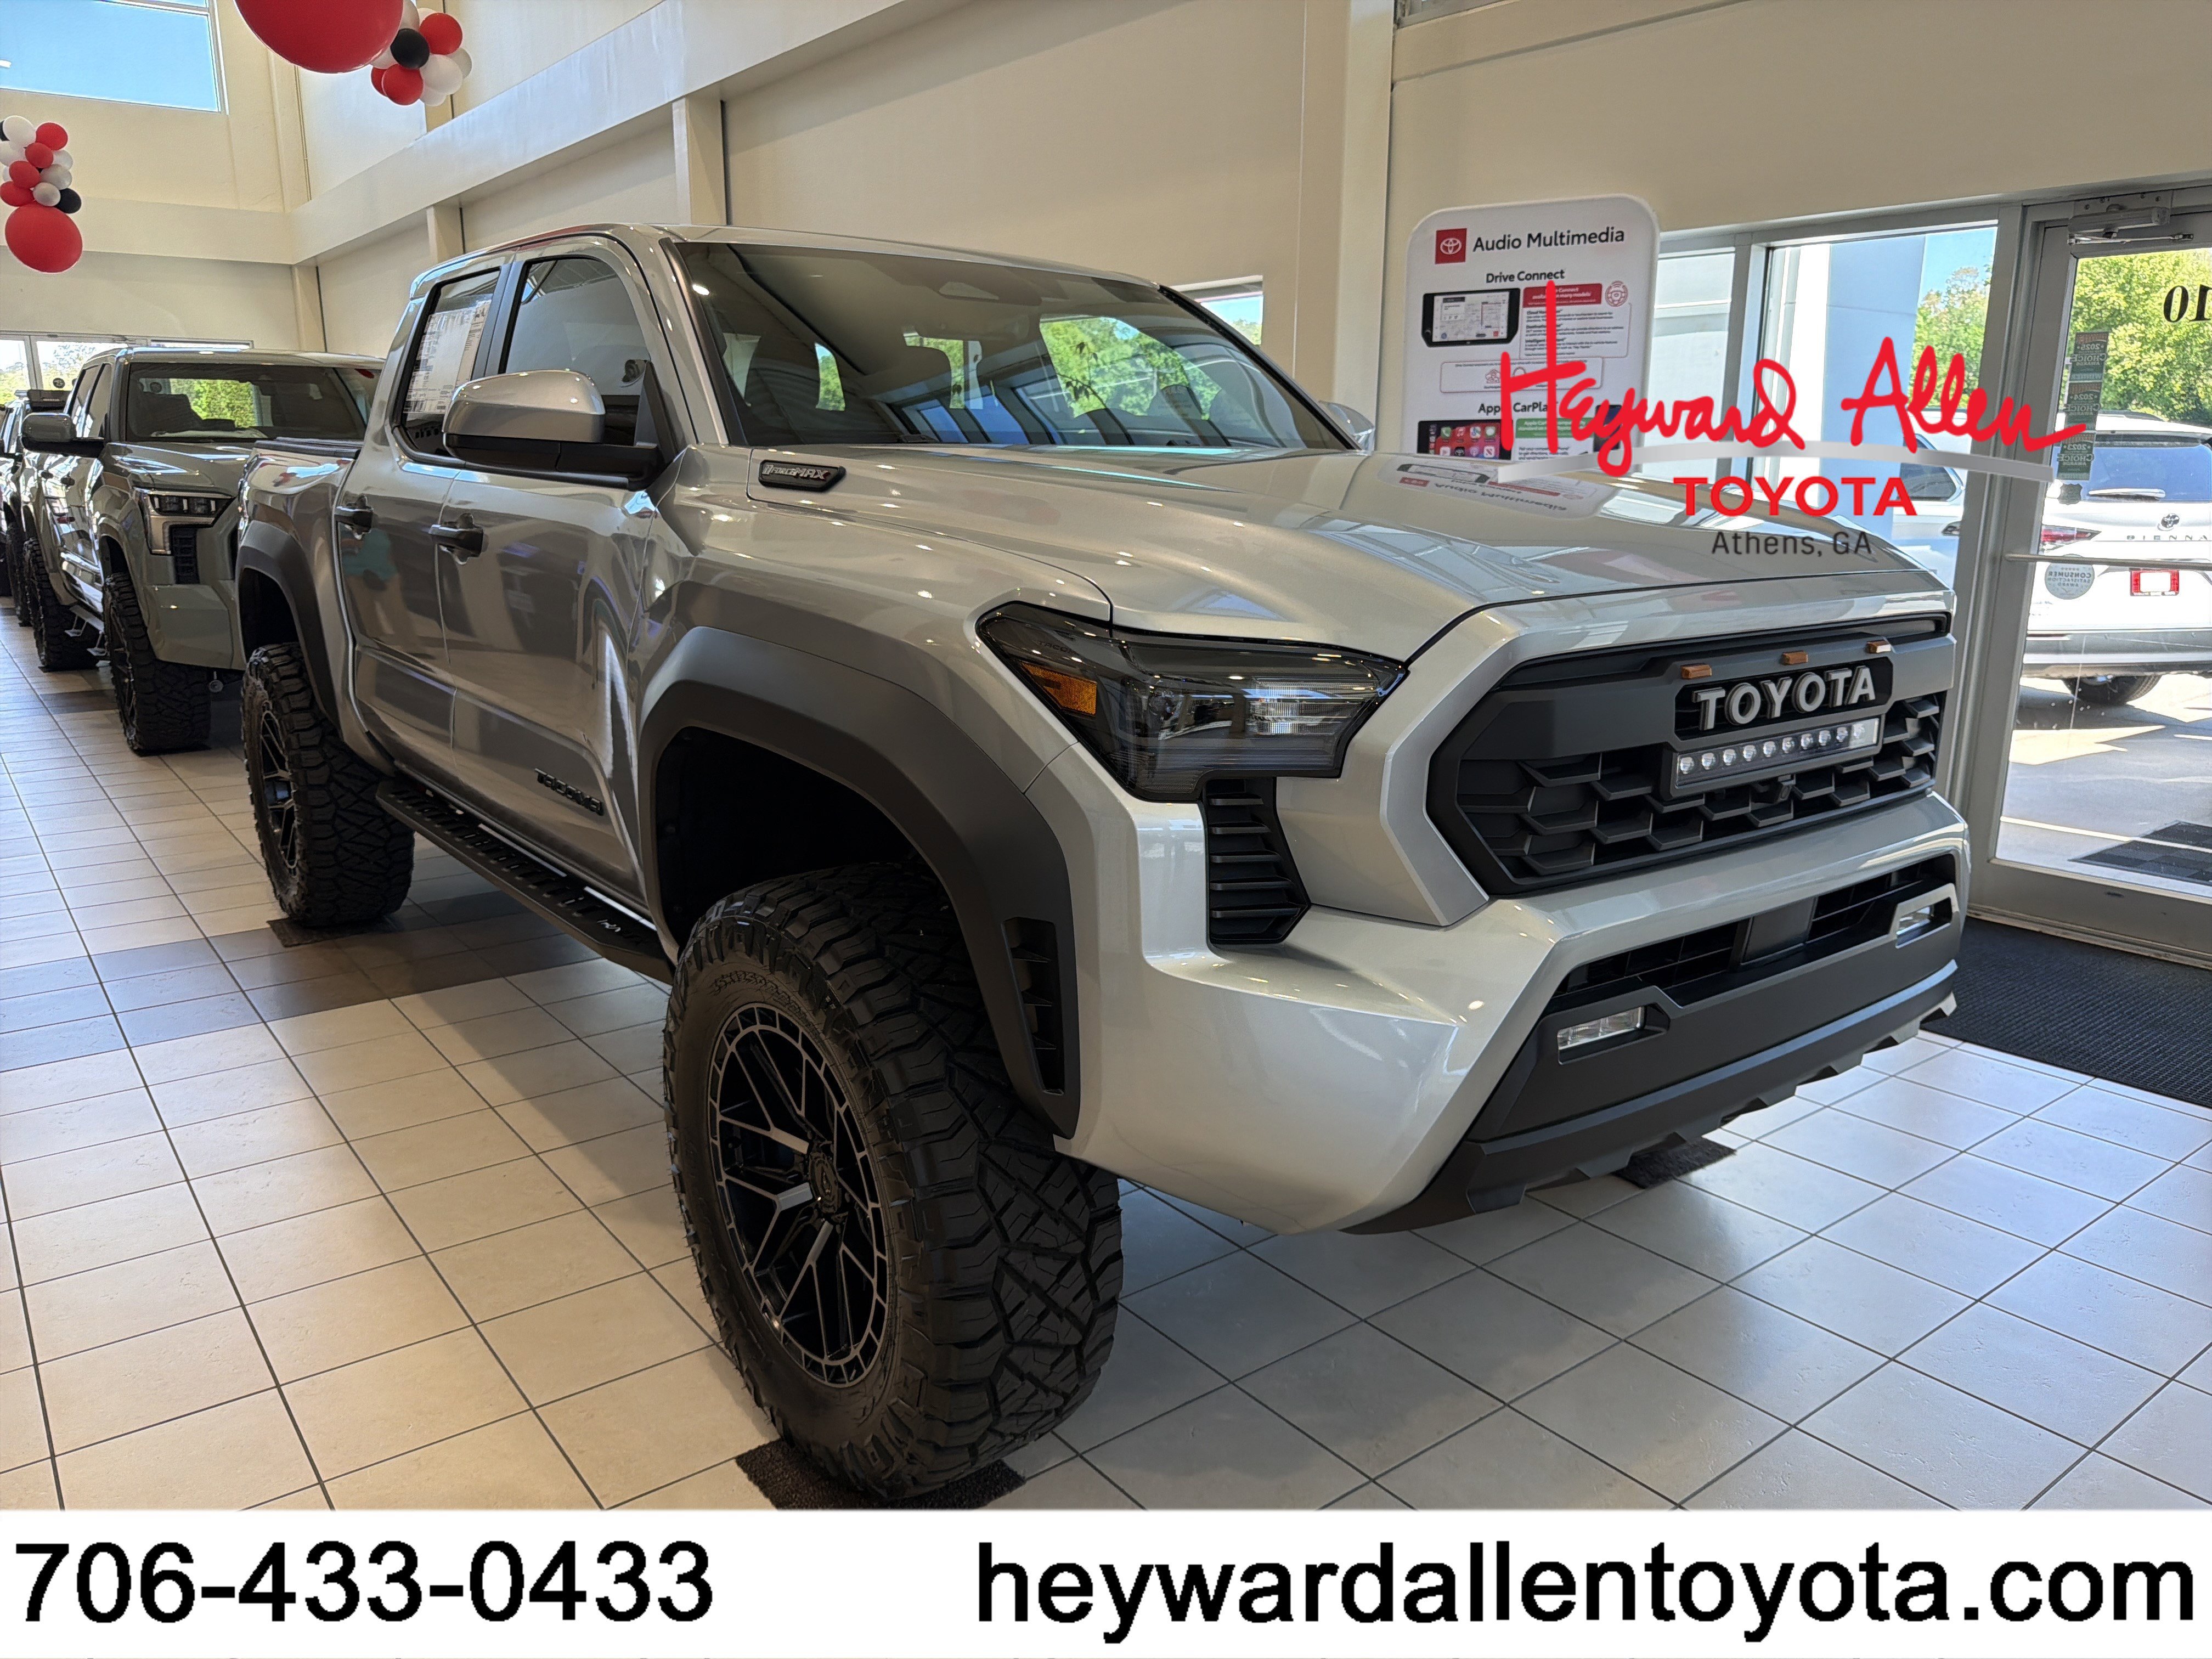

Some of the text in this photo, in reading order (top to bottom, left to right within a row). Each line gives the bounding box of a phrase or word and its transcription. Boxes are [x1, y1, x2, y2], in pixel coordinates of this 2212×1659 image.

[1472, 227, 1625, 252] Audio Multimedia
[1486, 269, 1565, 284] Drive Connect
[1478, 402, 1549, 416] App CarPla
[1692, 665, 1876, 731] TOYOTA
